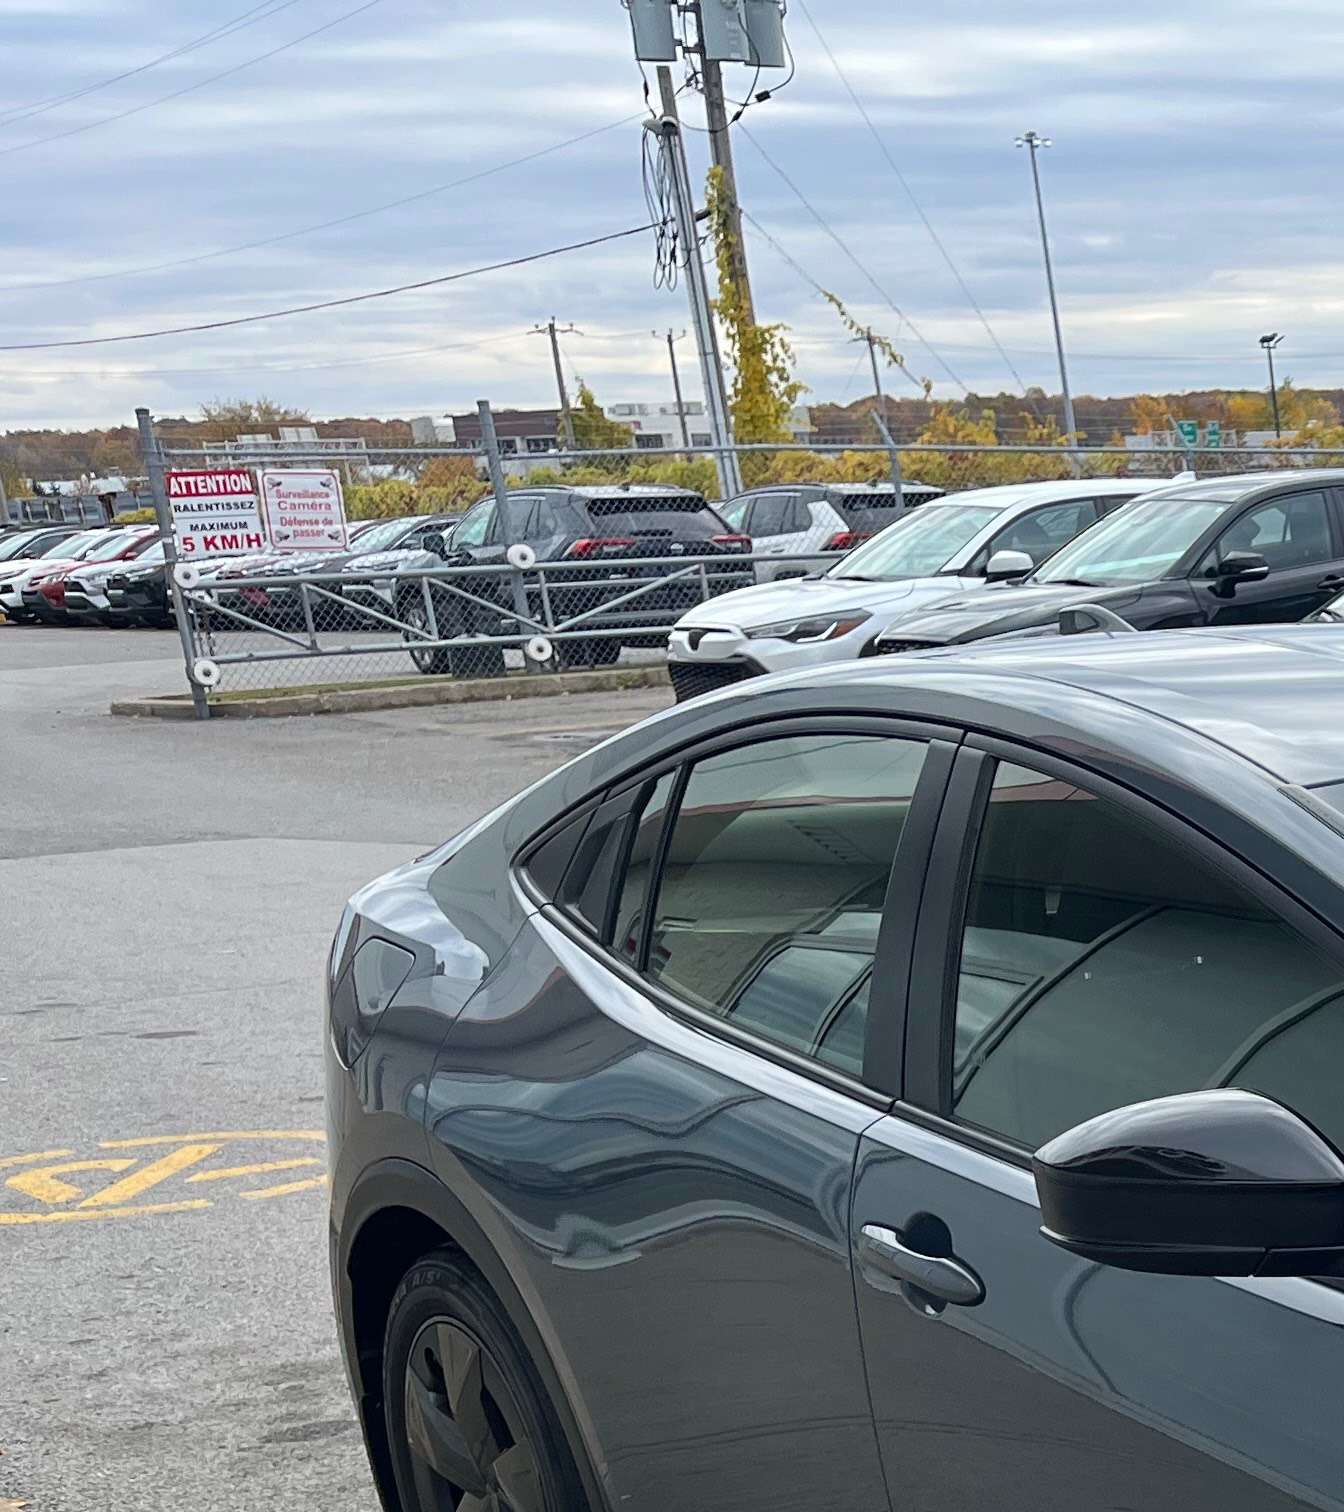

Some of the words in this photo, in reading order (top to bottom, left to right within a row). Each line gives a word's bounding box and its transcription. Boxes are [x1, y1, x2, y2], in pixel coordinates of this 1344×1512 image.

[170, 473, 252, 495] ATTENTION
[174, 501, 254, 513] RALENTISSEZ
[277, 500, 332, 511] Caméra
[190, 521, 248, 531] MAXIMUM
[280, 516, 320, 527] Défense
[322, 518, 334, 526] de
[182, 536, 195, 552] 5
[203, 532, 263, 551] KM/H
